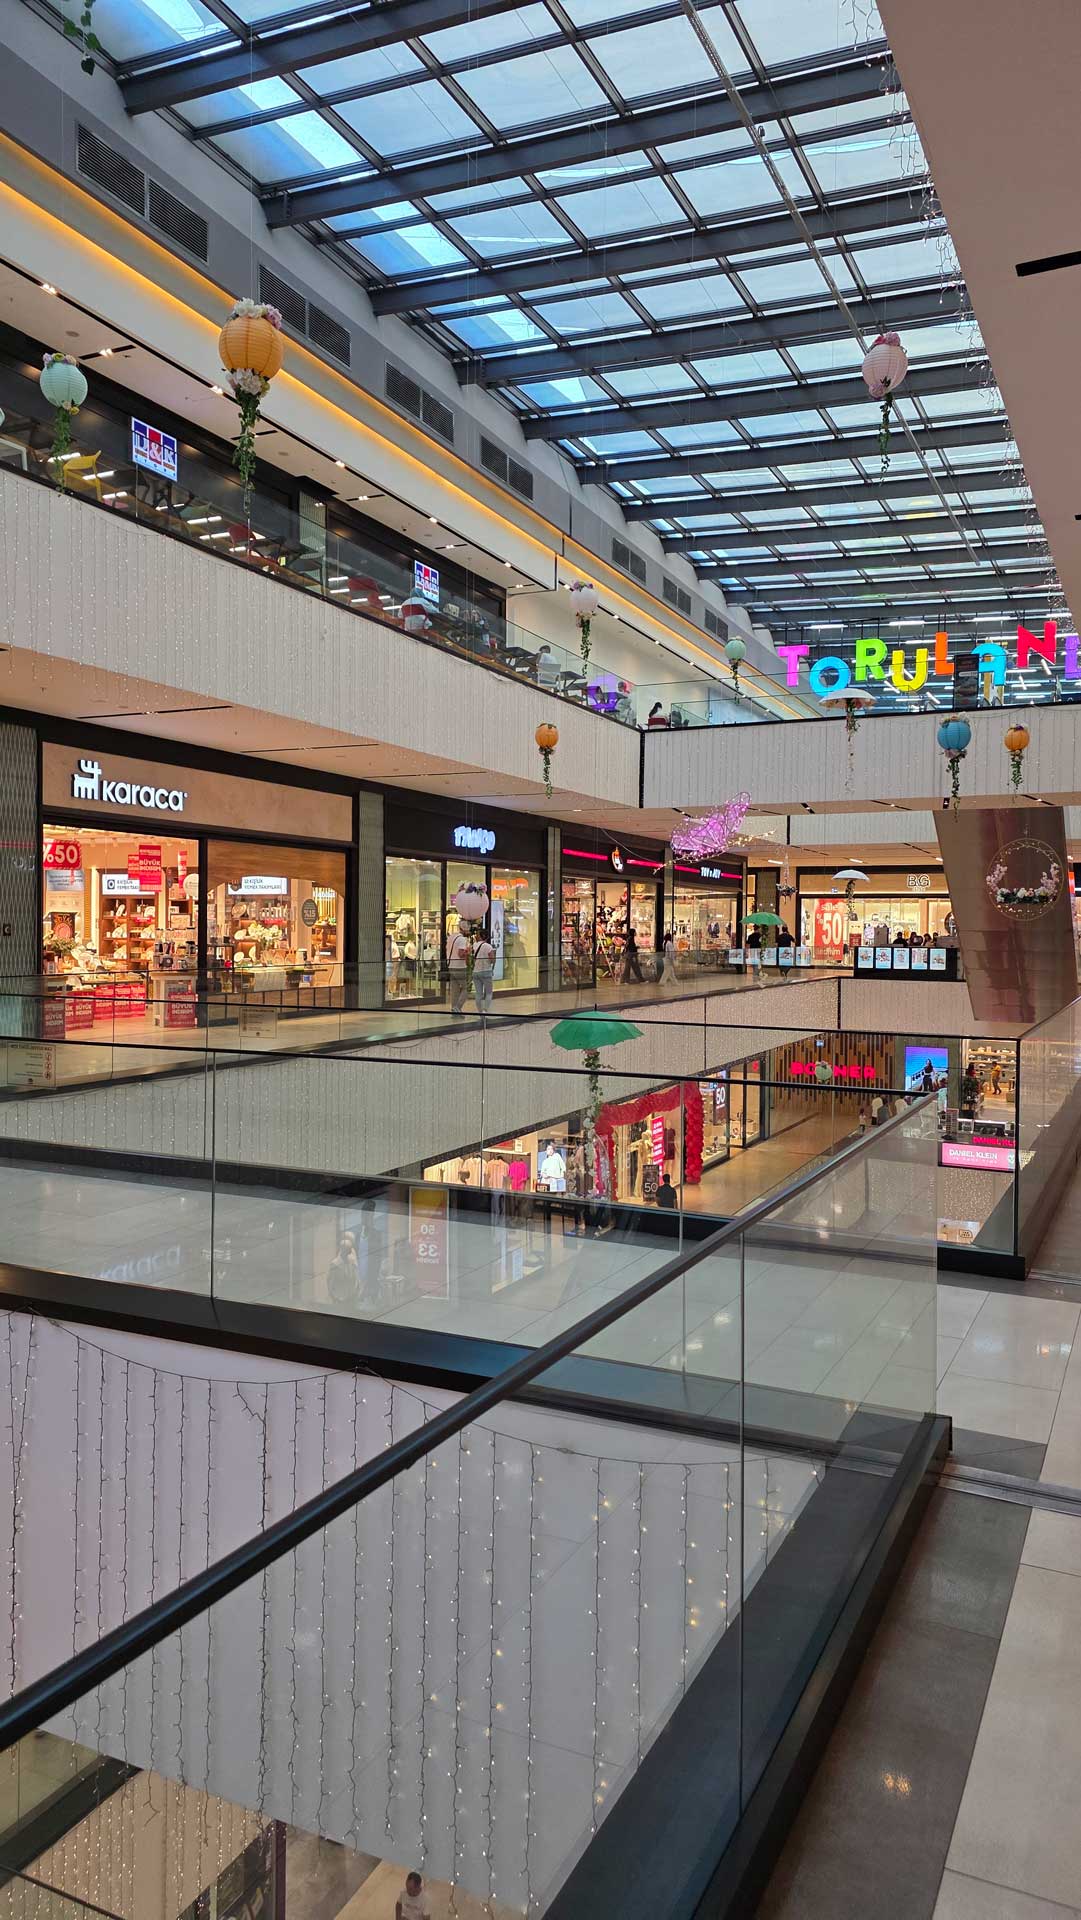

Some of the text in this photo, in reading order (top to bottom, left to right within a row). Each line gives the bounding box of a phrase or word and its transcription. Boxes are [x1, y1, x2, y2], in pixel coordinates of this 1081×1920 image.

[102, 780, 183, 811] karaca
[791, 1061, 875, 1078] BONER
[948, 1149, 998, 1159] DANIEL KLEIN
[645, 1182, 658, 1193] 50
